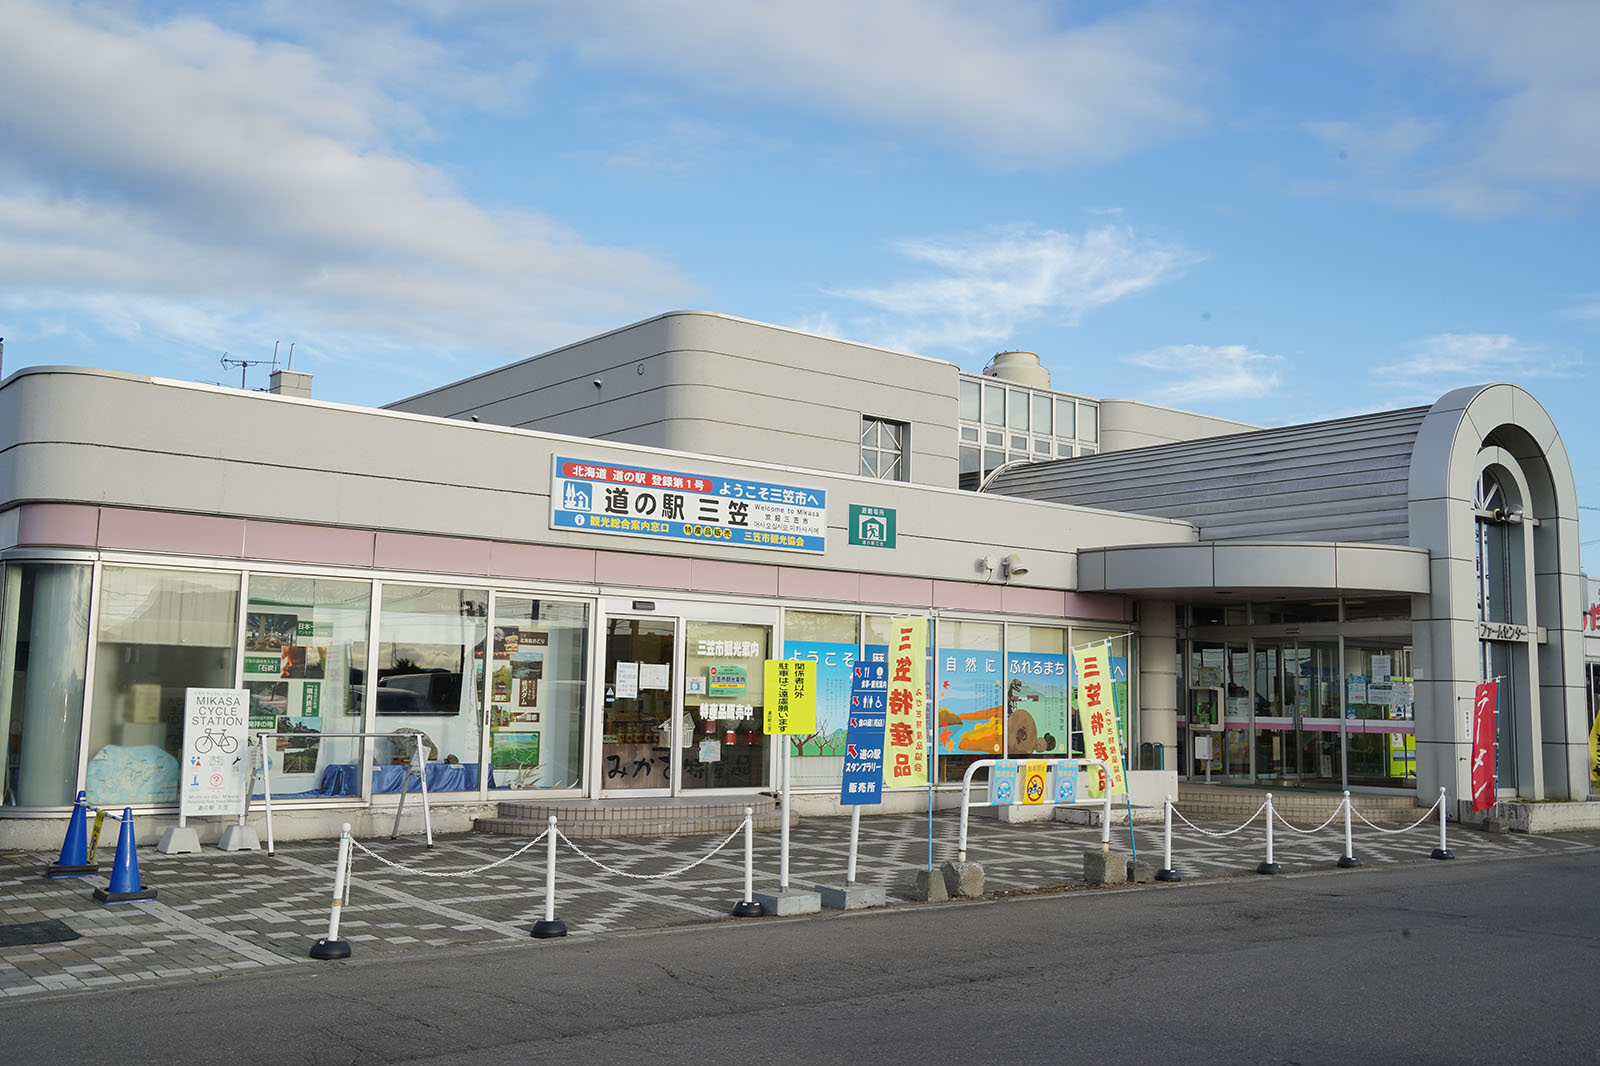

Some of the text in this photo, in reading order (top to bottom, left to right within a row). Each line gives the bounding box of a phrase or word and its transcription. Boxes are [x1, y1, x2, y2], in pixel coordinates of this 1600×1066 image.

[572, 464, 705, 491] 北海道 道の駅 登録第1号
[719, 482, 819, 506] ようこそ三笠市へ
[605, 487, 749, 527] 道の駅 三笠
[754, 503, 785, 514] Welcome
[797, 509, 820, 518] Mikasa
[590, 515, 670, 533] 観光総合案内窓口
[684, 524, 732, 540] 特産品販売
[743, 531, 805, 547] 三笠市観光協会
[1480, 623, 1528, 641] ファームセンター
[697, 639, 760, 658] 三笠市観光案内
[788, 649, 856, 669] ようこそ
[946, 656, 997, 673] 自然に
[1009, 659, 1066, 676] ふれるまち
[793, 663, 805, 699] 関係者以外
[196, 696, 241, 706] MIKASA
[777, 663, 789, 733] 駐車はご遠慮願います
[199, 706, 237, 716] CYCLE
[700, 703, 754, 720] 特産品販売中
[191, 716, 243, 726] STATION
[1472, 690, 1490, 800] ラーメン
[859, 748, 882, 760] 道の駅
[845, 762, 882, 773] スタンプラリー
[848, 781, 877, 794] 販売所
